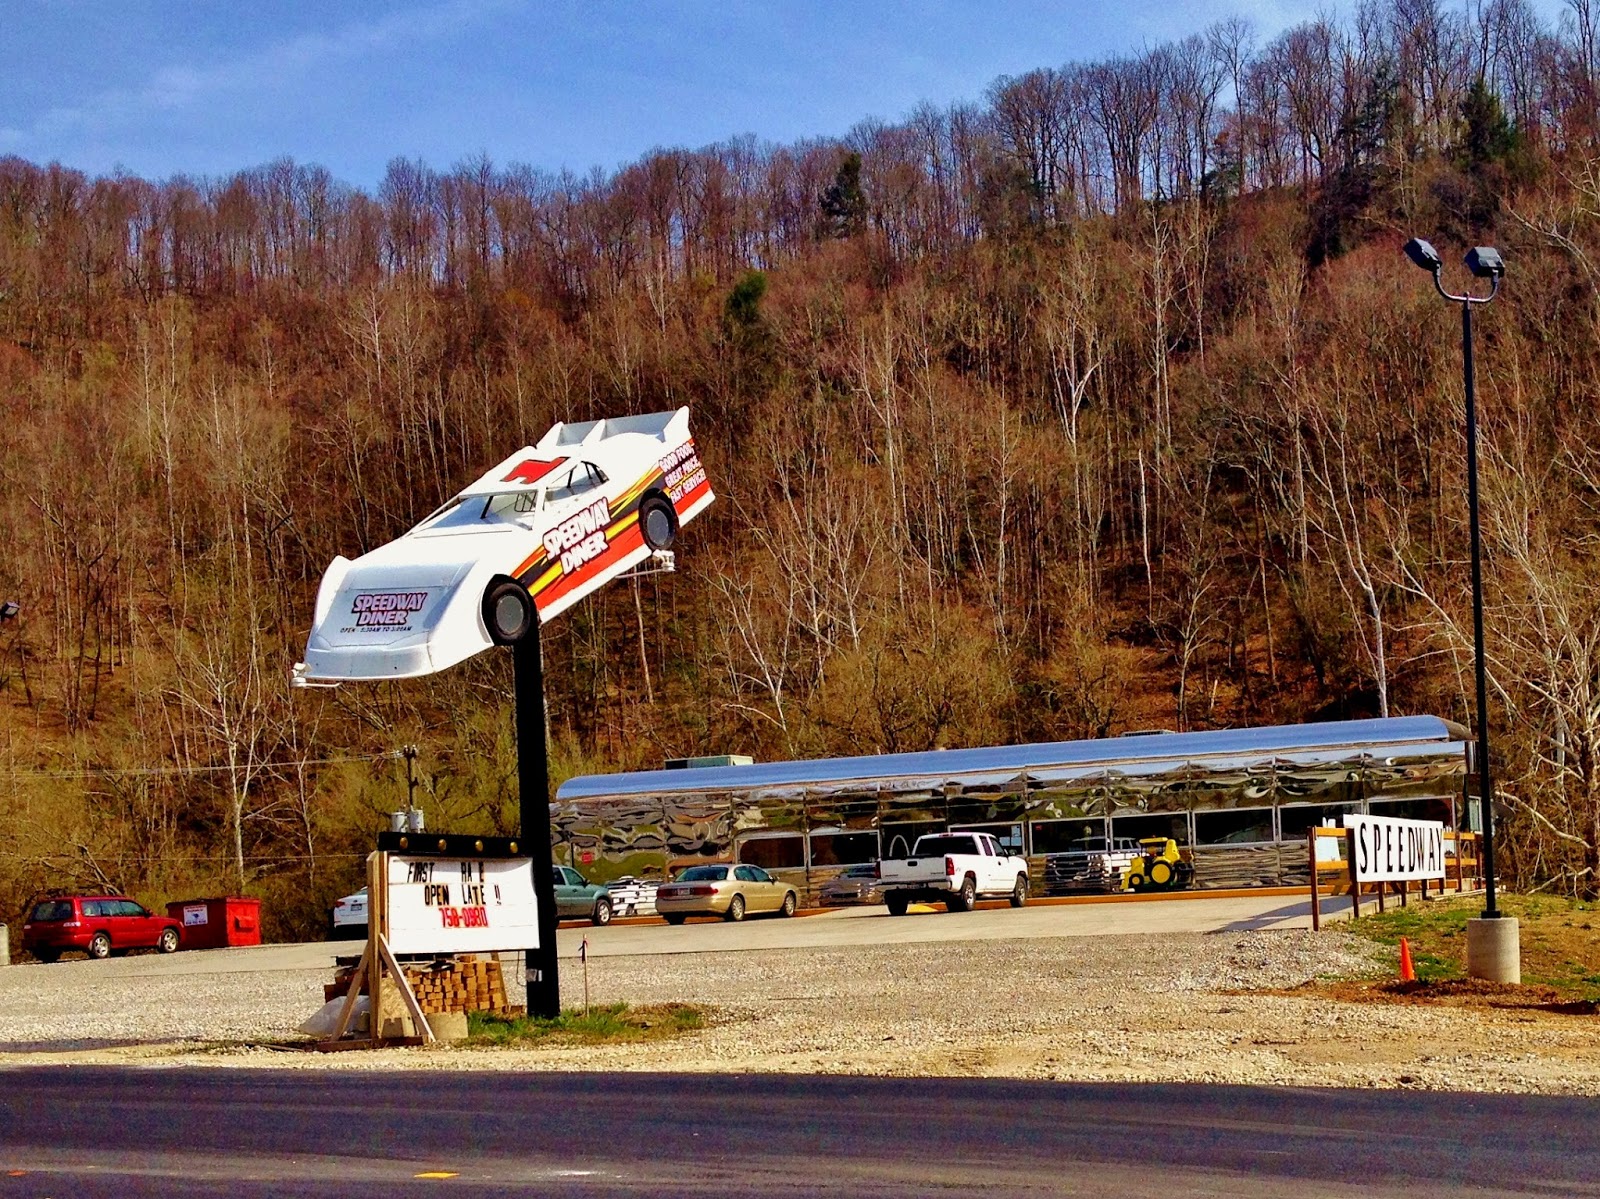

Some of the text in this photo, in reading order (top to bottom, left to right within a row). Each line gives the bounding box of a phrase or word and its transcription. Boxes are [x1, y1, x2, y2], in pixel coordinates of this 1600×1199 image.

[659, 451, 679, 473] GOOD
[542, 497, 612, 561] SPEEDWAY
[560, 529, 609, 576] DINER
[351, 592, 428, 614] SPEEDWAY
[356, 610, 409, 627] DINER
[1359, 821, 1443, 874] SPEEDWAY
[407, 861, 435, 883] FIRST
[424, 885, 449, 906] OPEN
[461, 885, 487, 905] LATE
